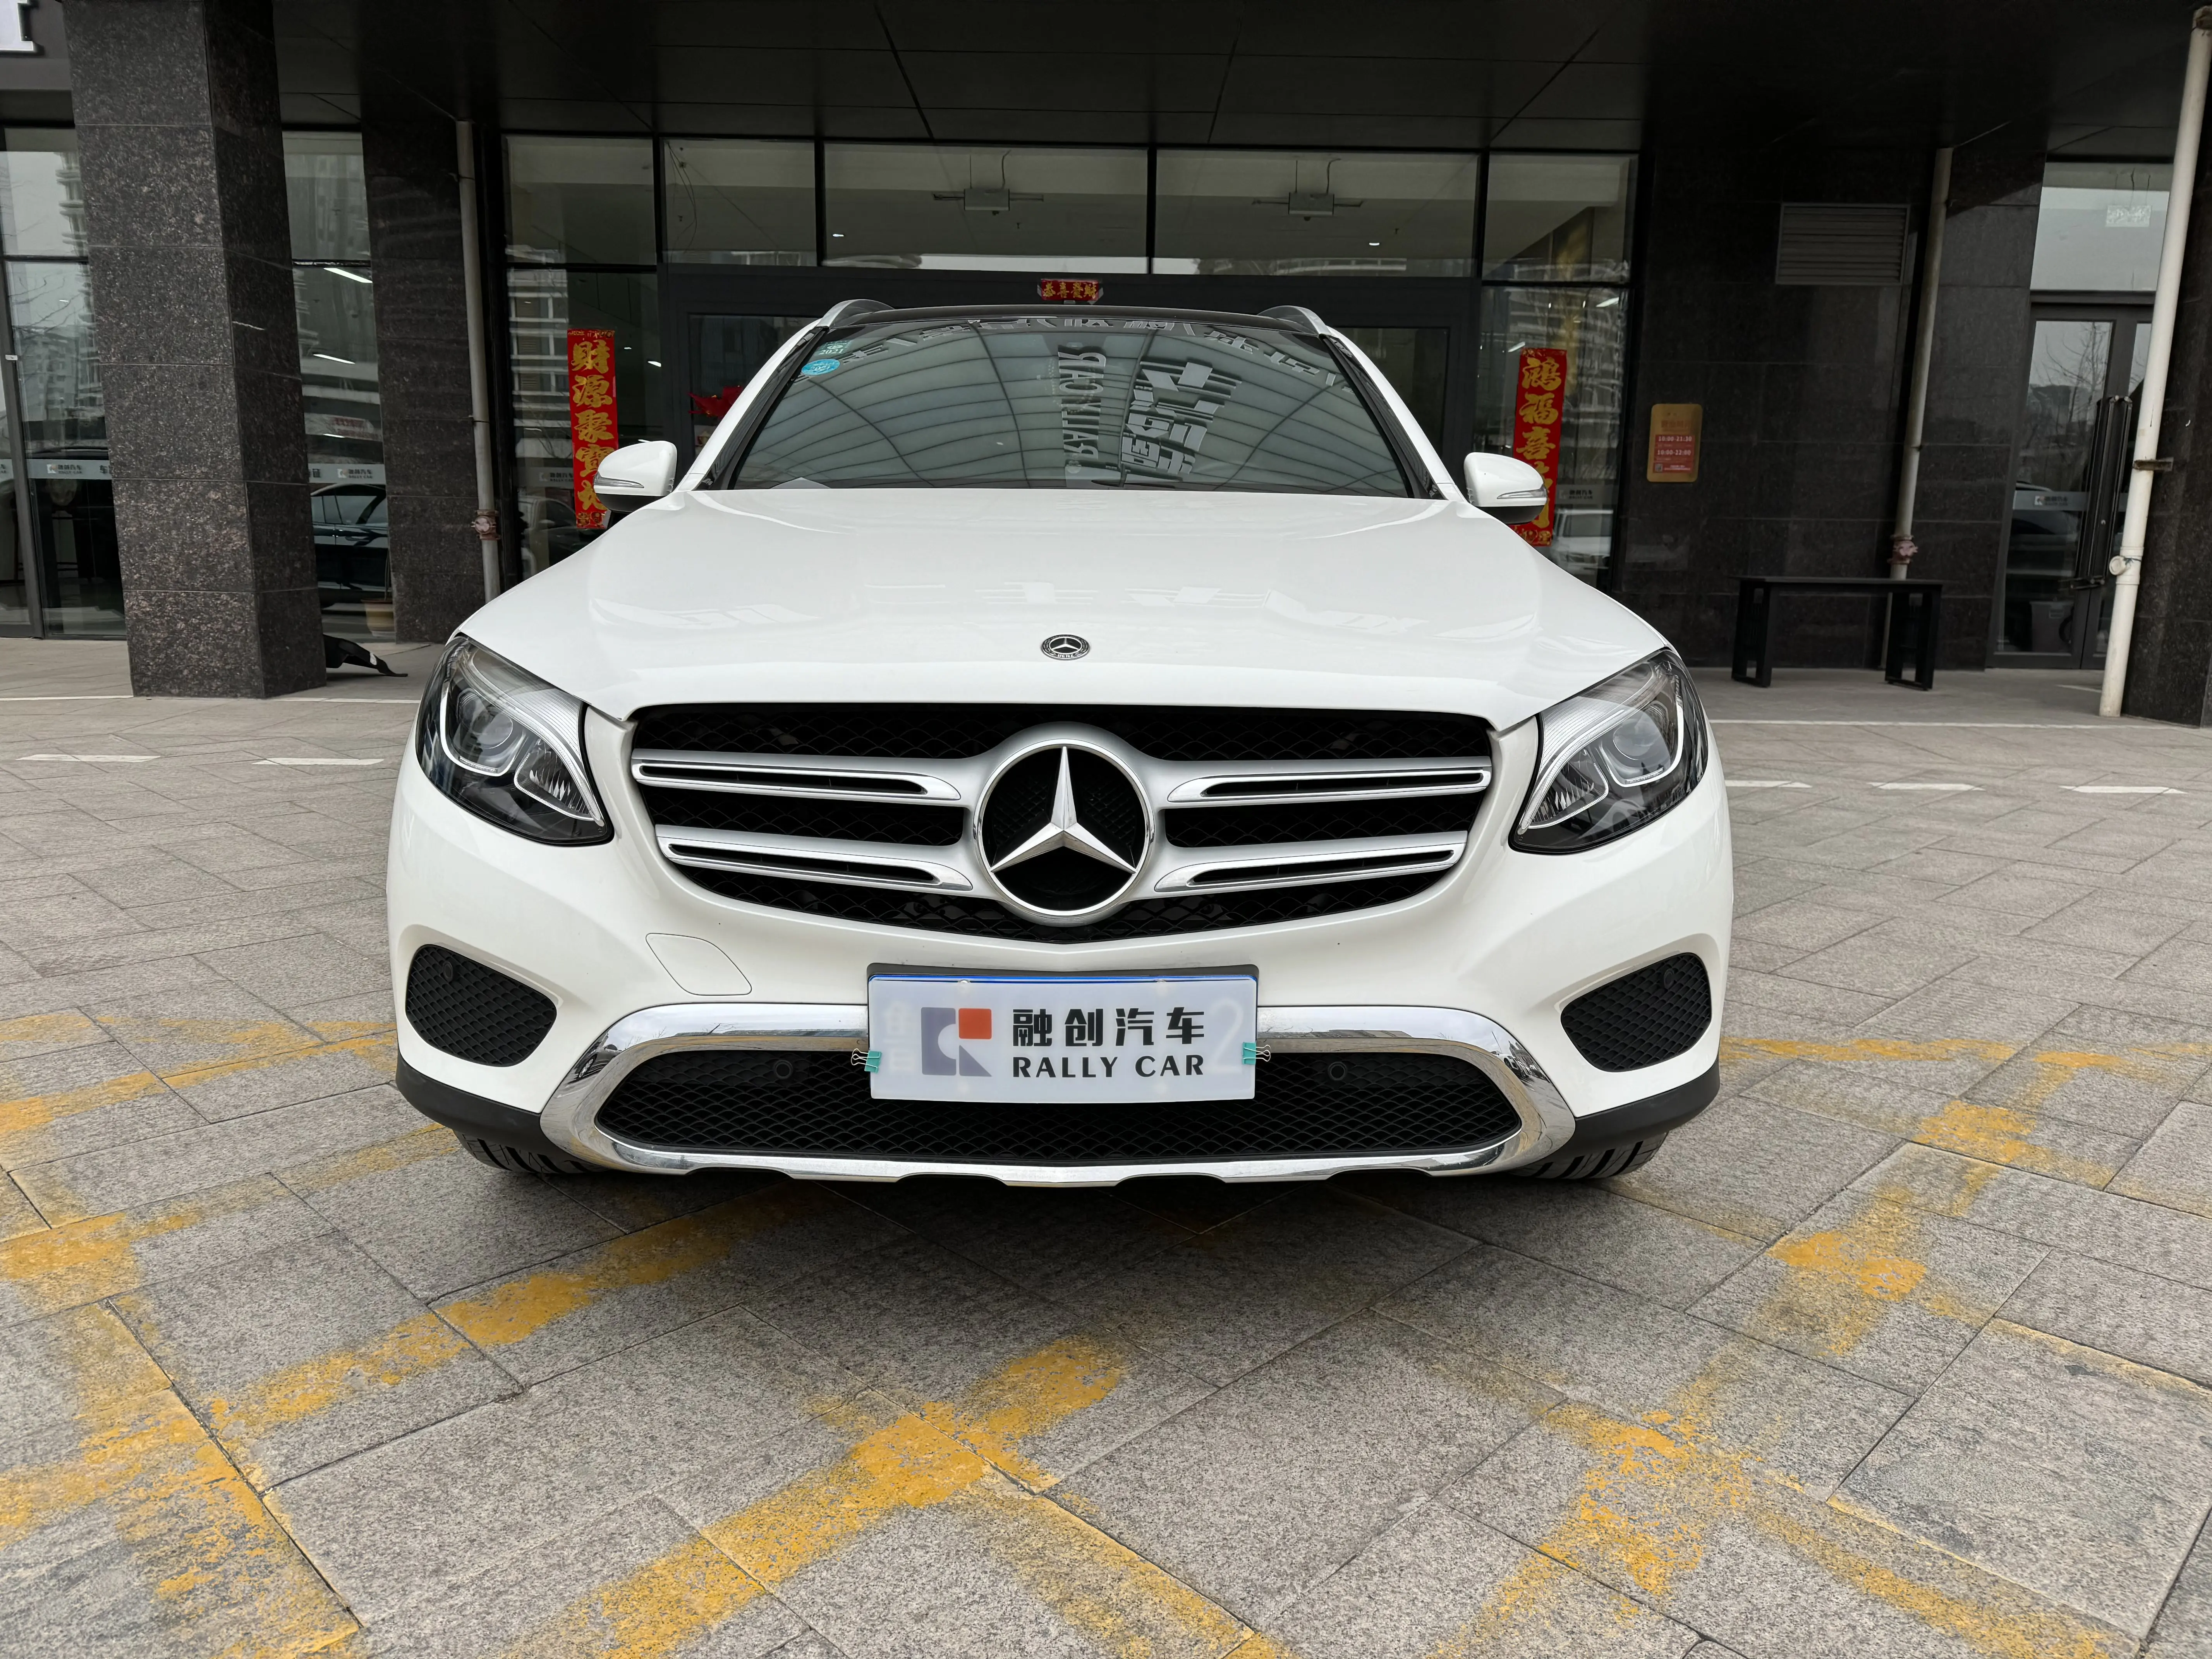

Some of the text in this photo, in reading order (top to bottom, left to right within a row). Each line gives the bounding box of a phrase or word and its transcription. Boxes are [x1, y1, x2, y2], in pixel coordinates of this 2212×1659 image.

[1013, 1007, 1204, 1046] 融创汽车
[1013, 1054, 1203, 1078] RALLY CAR
